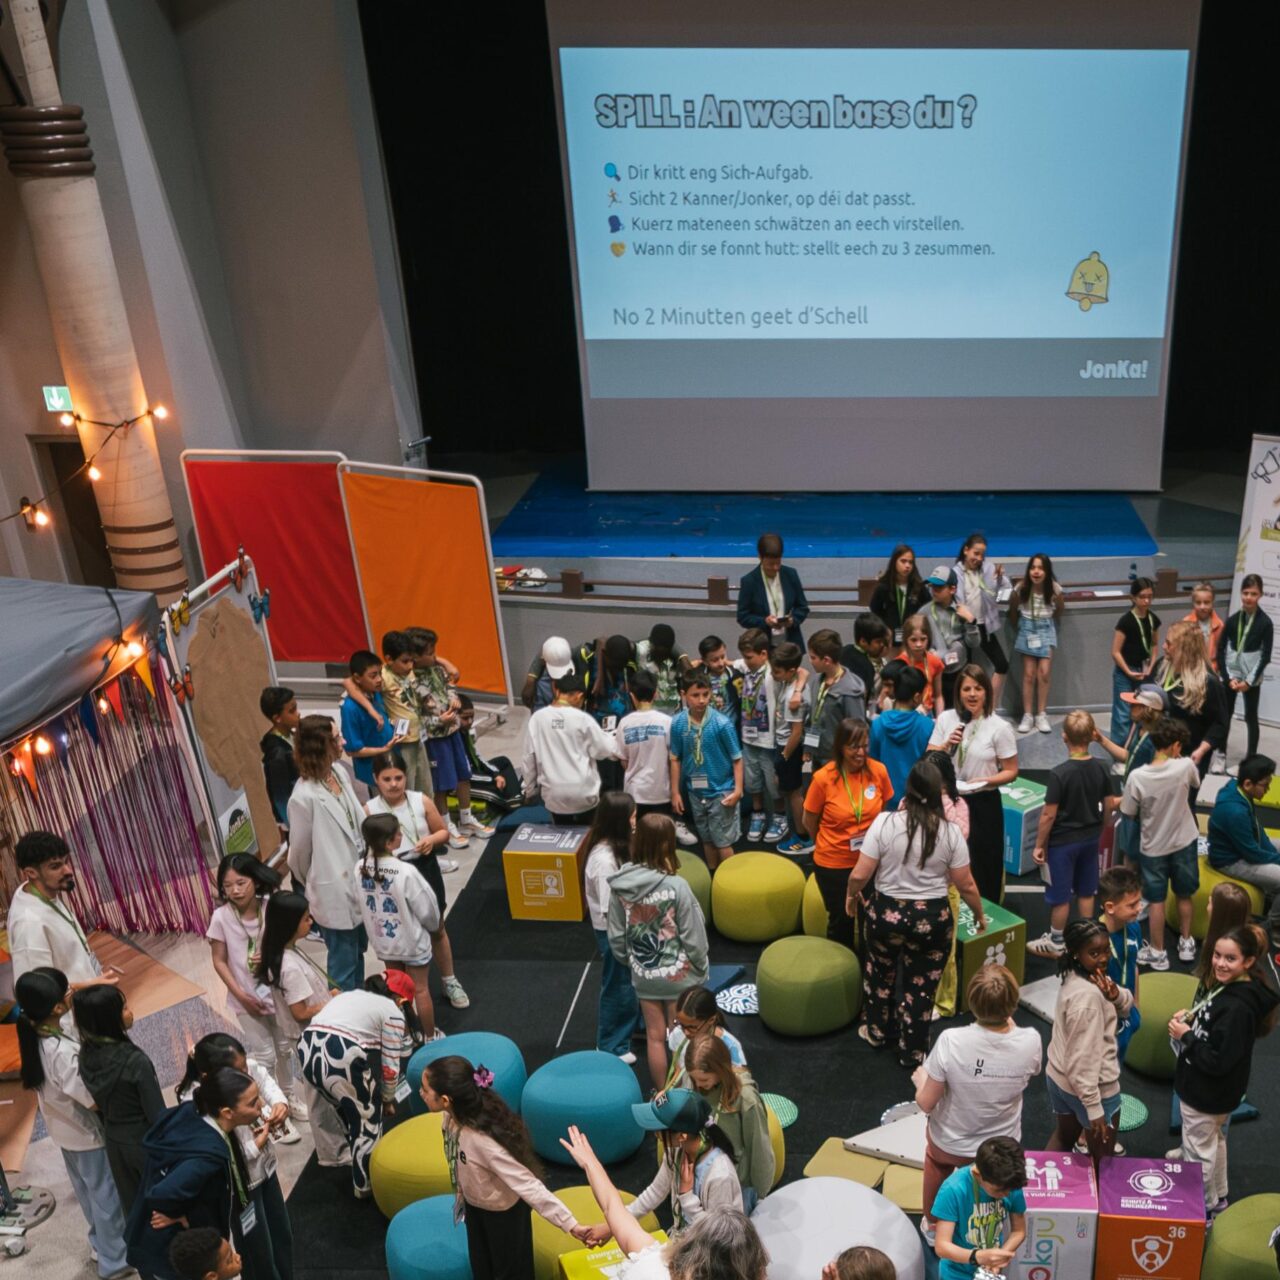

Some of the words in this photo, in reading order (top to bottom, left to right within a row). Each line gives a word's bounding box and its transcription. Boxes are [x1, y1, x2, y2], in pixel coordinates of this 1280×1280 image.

[594, 93, 681, 129] SPILL
[698, 94, 741, 128] An
[743, 98, 830, 129] ween
[833, 94, 911, 129] bass
[913, 94, 954, 129] du
[957, 93, 978, 129] ?
[627, 164, 650, 181] Dir
[653, 164, 687, 181] kritt
[689, 168, 718, 184] eng
[720, 164, 814, 184] Sich-Aufgab.
[628, 190, 666, 206] Sicht
[669, 191, 678, 206] 2
[682, 190, 793, 209] Kanner/Jonker,
[795, 194, 815, 209] op
[818, 190, 841, 207] déi
[844, 190, 870, 206] dat
[872, 191, 916, 209] passt.
[631, 217, 673, 232] Kuerz
[676, 217, 751, 232] mateneen
[754, 215, 831, 232] schwätzen
[833, 219, 852, 232] an
[855, 215, 890, 232] eech
[892, 215, 965, 232] virstellen.
[632, 242, 675, 257] Wann
[677, 240, 698, 257] dir
[700, 244, 718, 256] se
[720, 240, 762, 256] fonnt
[764, 240, 800, 257] hutt:
[802, 240, 841, 256] stellt
[843, 240, 879, 256] eech
[881, 244, 899, 256] zu
[902, 241, 911, 256] 3
[914, 244, 996, 257] zesummen.
[613, 307, 640, 326] No
[644, 307, 656, 326] 2
[661, 306, 746, 325] Minutten
[750, 307, 793, 329] geet
[1080, 360, 1148, 379] JonKa!
[1005, 931, 1015, 943] 21
[1062, 1156, 1072, 1166] 3
[1164, 1162, 1182, 1173] 38
[1168, 1226, 1186, 1239] 36
